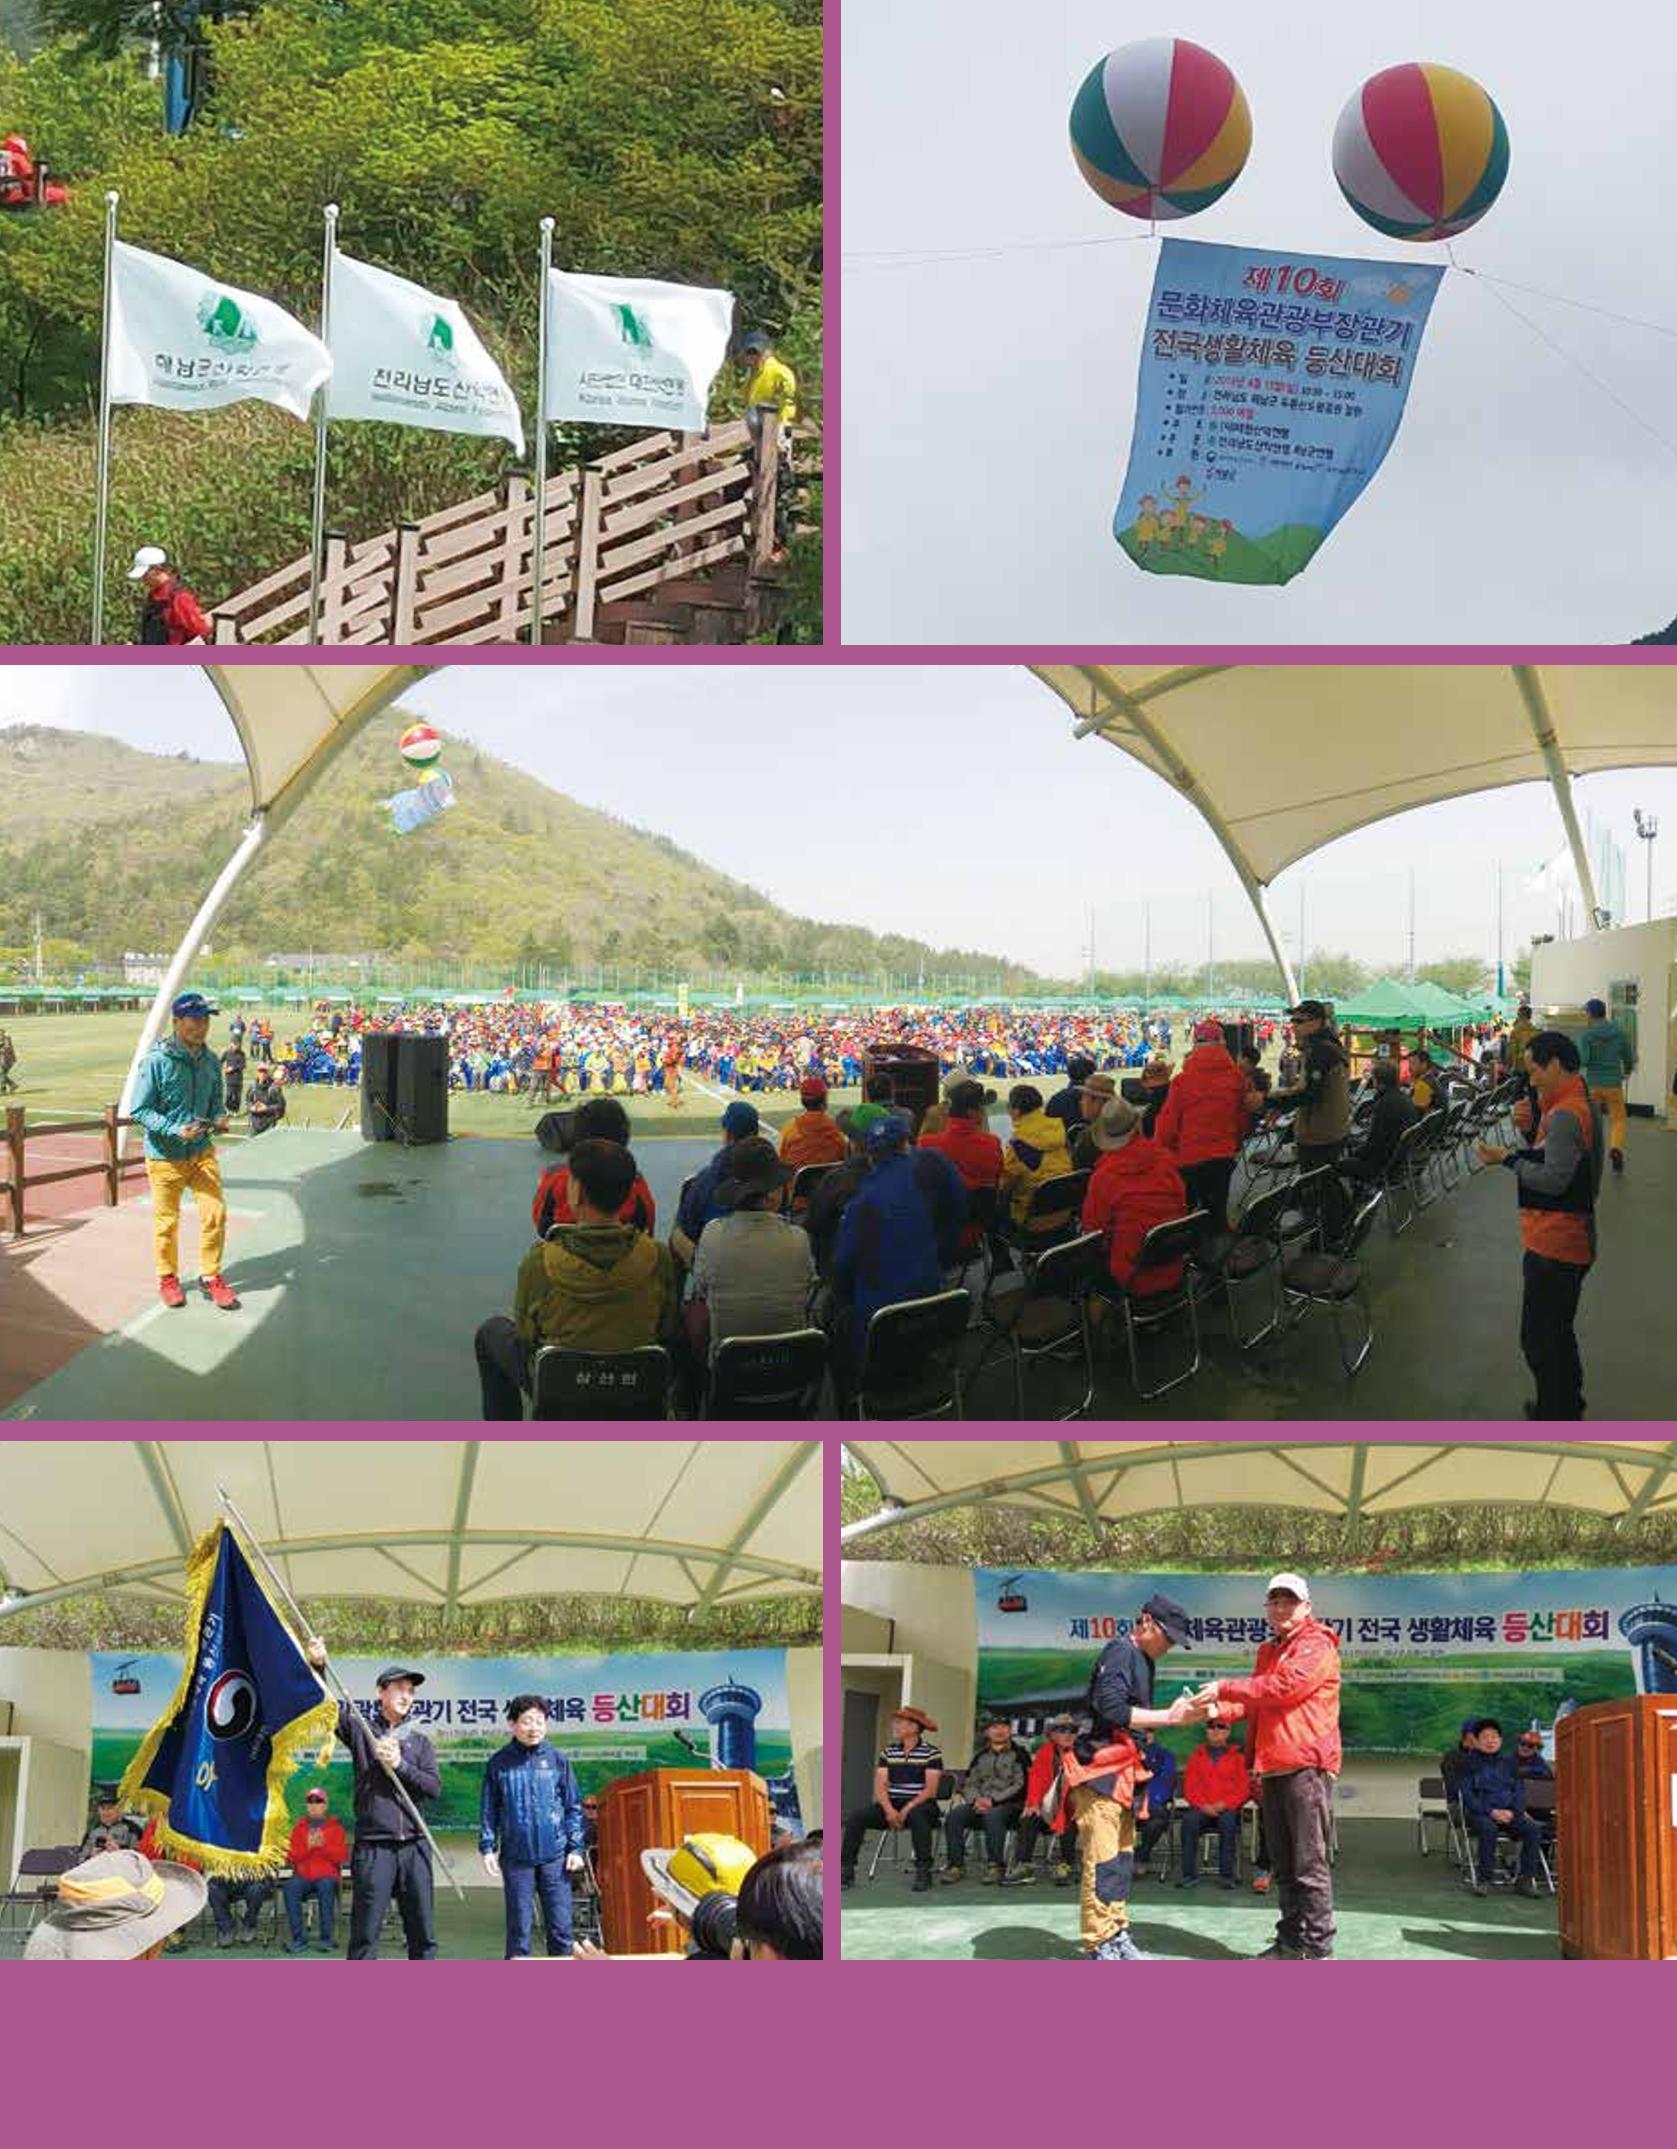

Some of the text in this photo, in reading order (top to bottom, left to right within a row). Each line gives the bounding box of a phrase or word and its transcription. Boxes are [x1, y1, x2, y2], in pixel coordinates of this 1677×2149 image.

[1243, 264, 1346, 303] 제10회
[1157, 290, 1414, 350] 문화체육관광부장관기
[1152, 327, 1404, 389] 전국생활체육 등산대회
[1357, 1616, 1402, 1643] 전국
[1406, 1615, 1498, 1643] 생활체육
[1501, 1608, 1610, 1643] 등산대회
[456, 1699, 499, 1725] 전국
[590, 1691, 692, 1723] 등산대회
